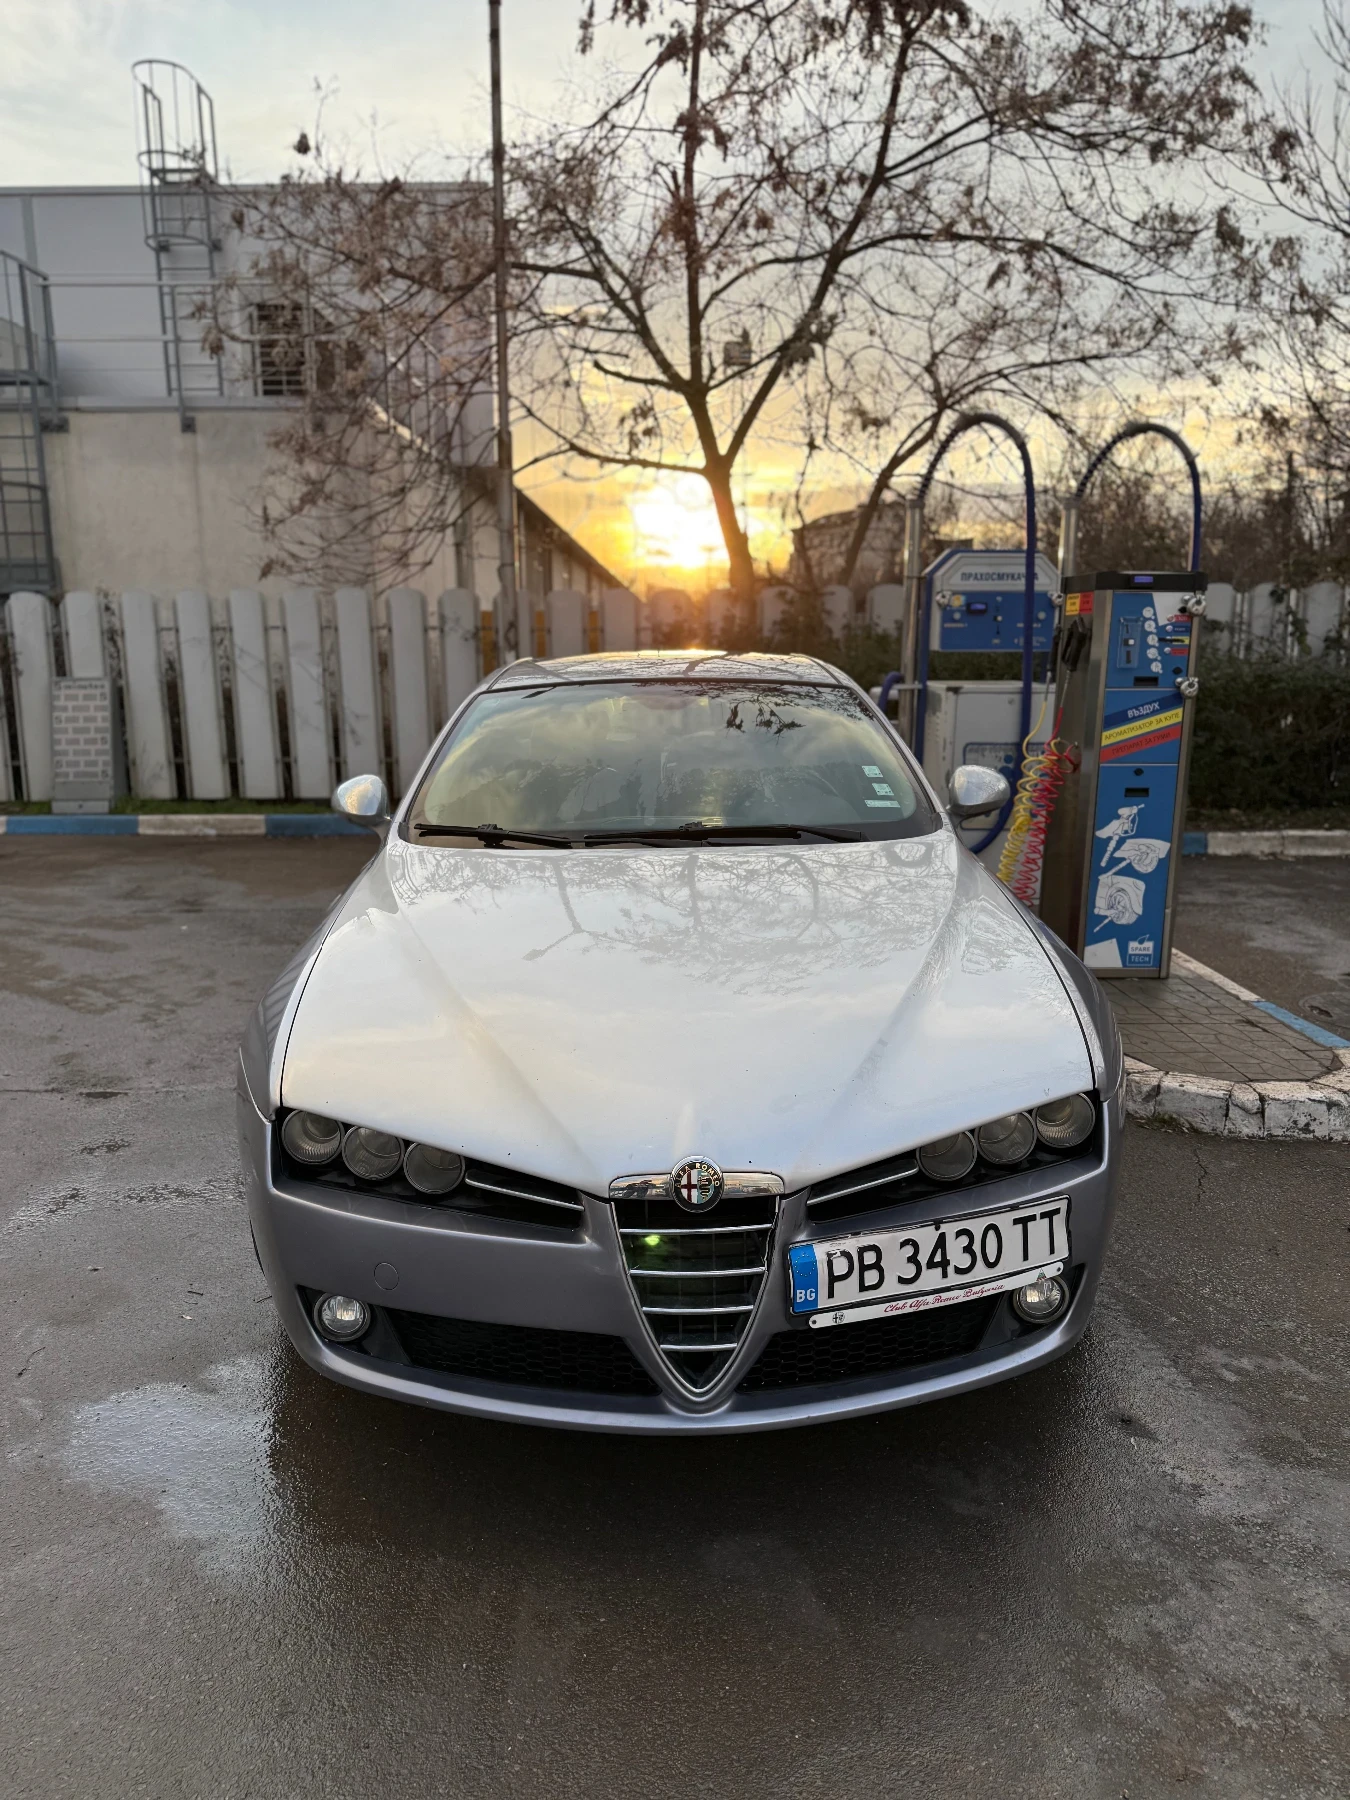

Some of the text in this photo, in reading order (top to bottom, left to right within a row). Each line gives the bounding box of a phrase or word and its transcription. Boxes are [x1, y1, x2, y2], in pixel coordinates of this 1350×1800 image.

[961, 572, 1040, 582] ПРАХОСМУКАЧА
[1127, 701, 1160, 718] ВЪЗДУХ
[1104, 711, 1180, 740] АРОМАТИЗАТОР ЗА КУПЕ
[1112, 731, 1171, 755] ПРЕПАРАТ ЗА ГУМИ
[675, 1163, 720, 1188] ALFA ROMEO
[826, 1207, 1061, 1299] PB 3430 TT
[796, 1288, 816, 1303] BG
[883, 1302, 907, 1313] Club
[962, 1284, 1006, 1298] Bulgaria
